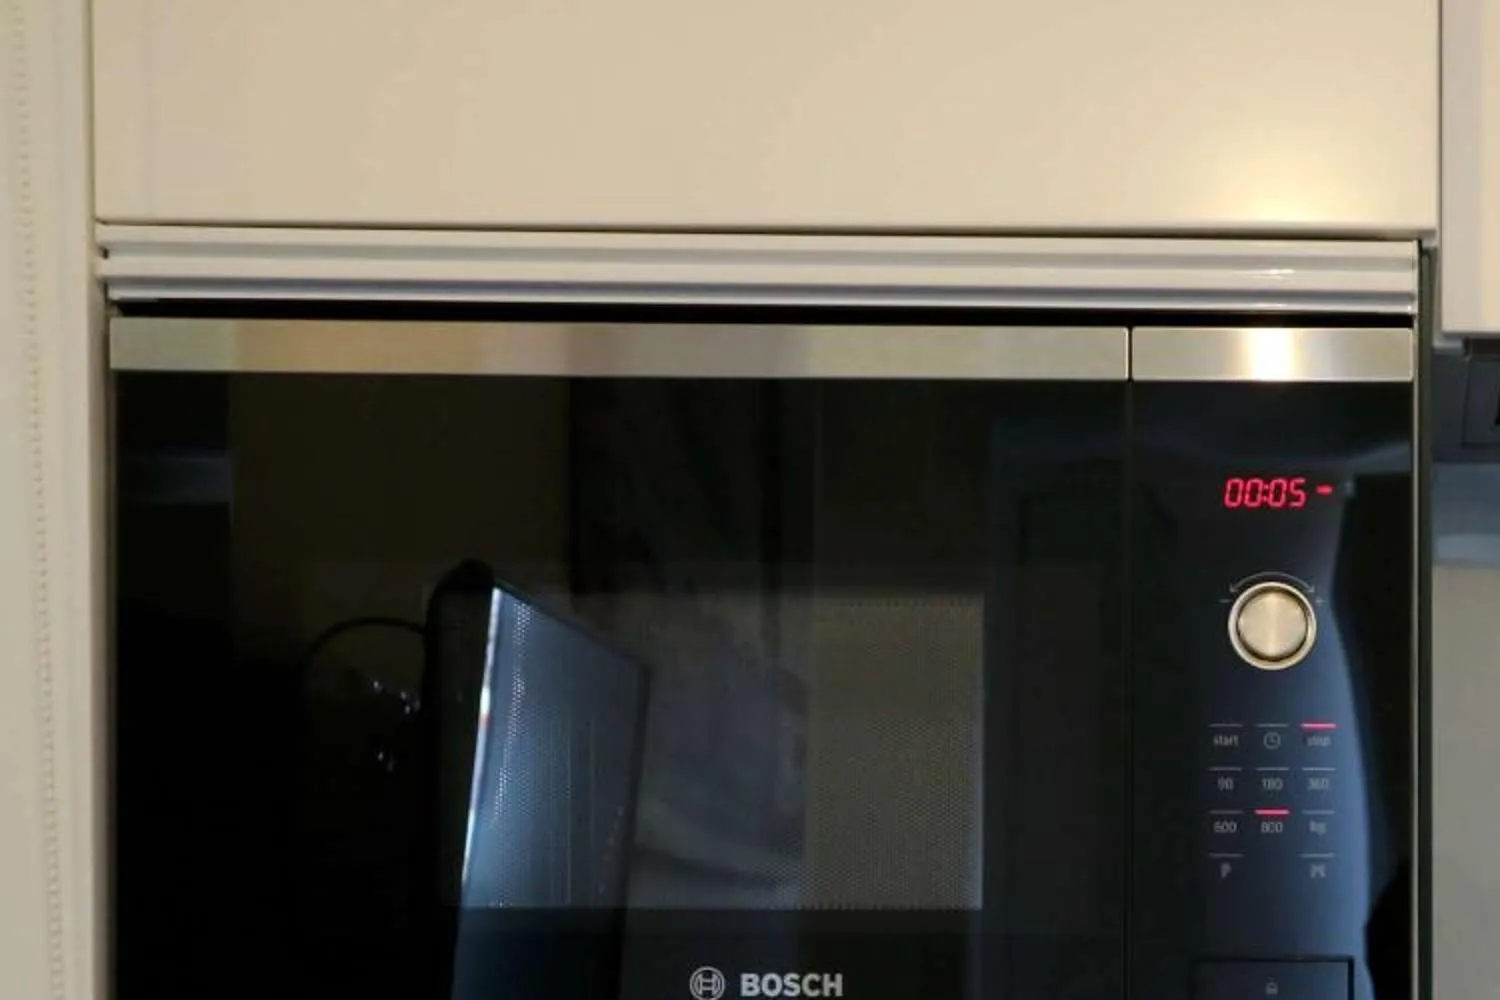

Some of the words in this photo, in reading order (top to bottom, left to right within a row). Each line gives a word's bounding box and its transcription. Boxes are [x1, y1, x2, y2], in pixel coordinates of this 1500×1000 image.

[1223, 478, 1308, 509] 00:05
[1213, 821, 1237, 834] 600
[1261, 821, 1284, 834] 800
[739, 972, 844, 998] BOSCH
